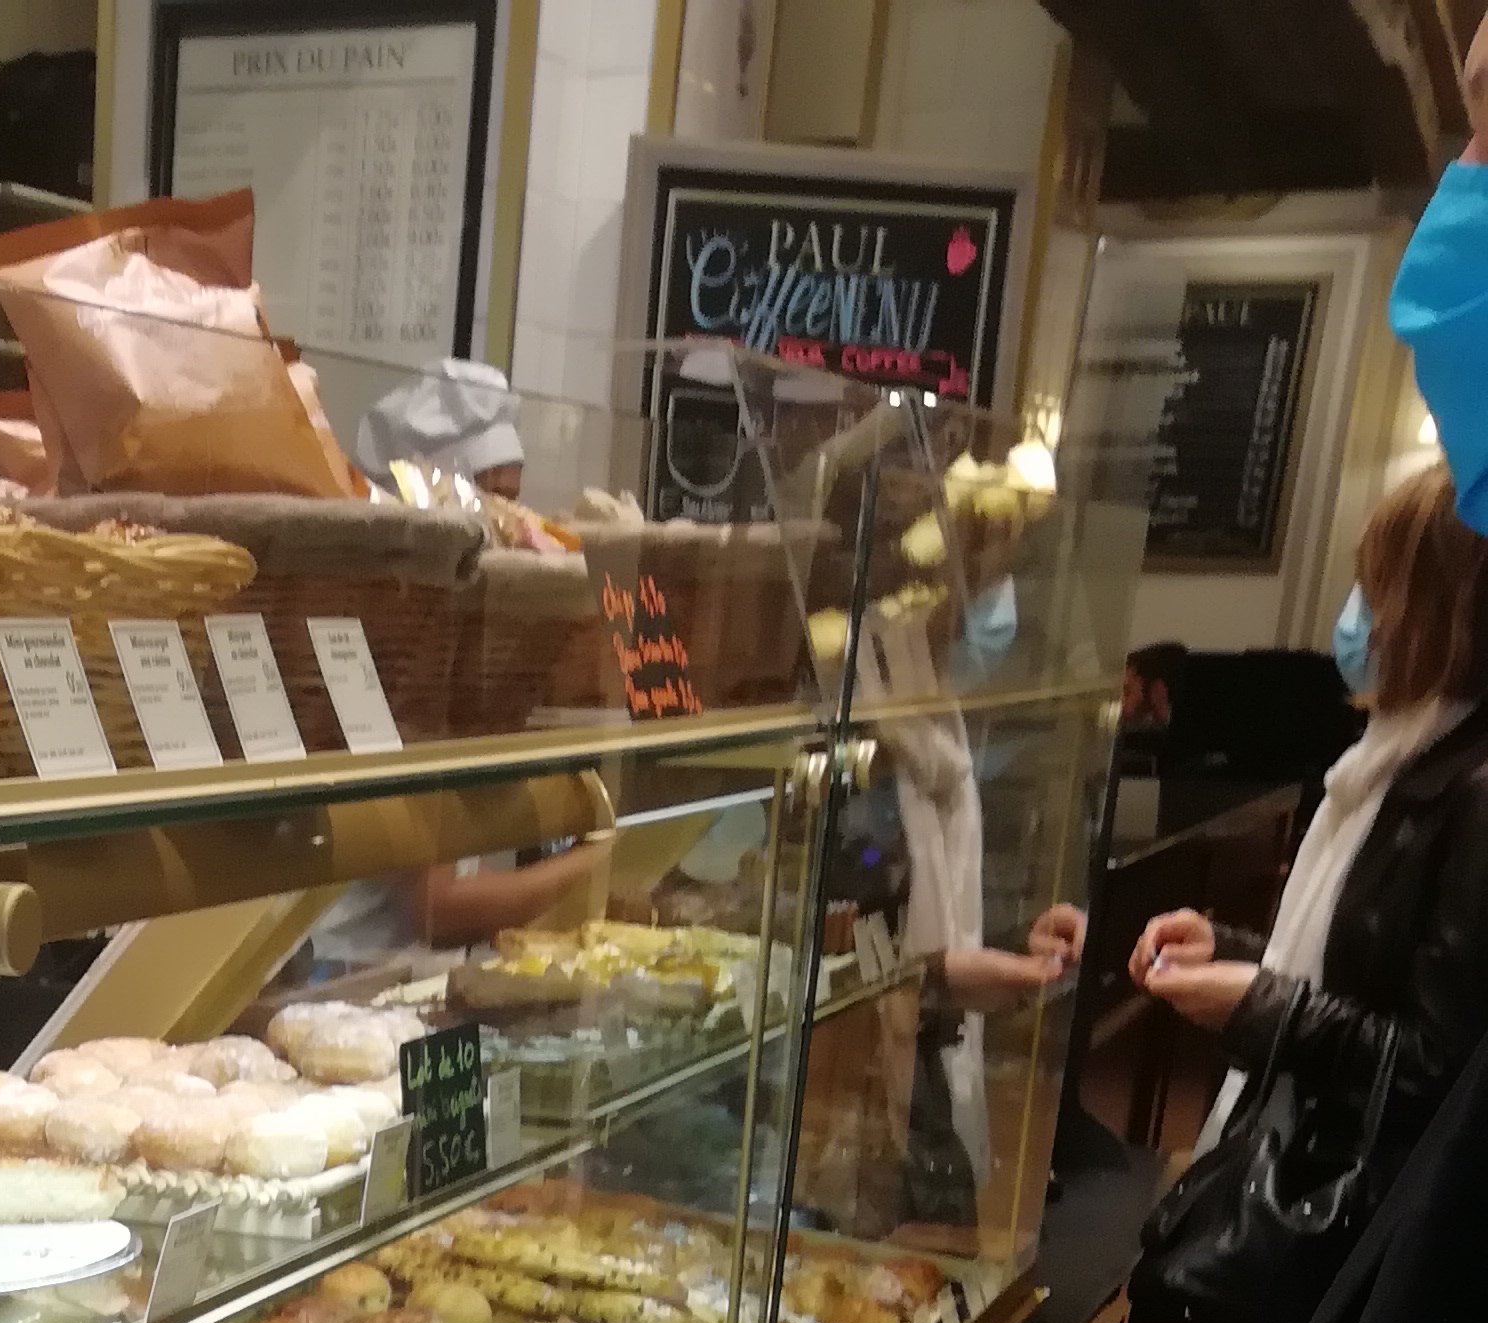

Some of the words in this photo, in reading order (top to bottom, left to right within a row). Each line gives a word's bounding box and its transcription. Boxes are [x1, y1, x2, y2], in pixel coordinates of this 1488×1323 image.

[232, 49, 288, 76] PRIX
[297, 49, 334, 74] DU
[344, 42, 406, 73] PAIN
[768, 217, 895, 276] PAUL
